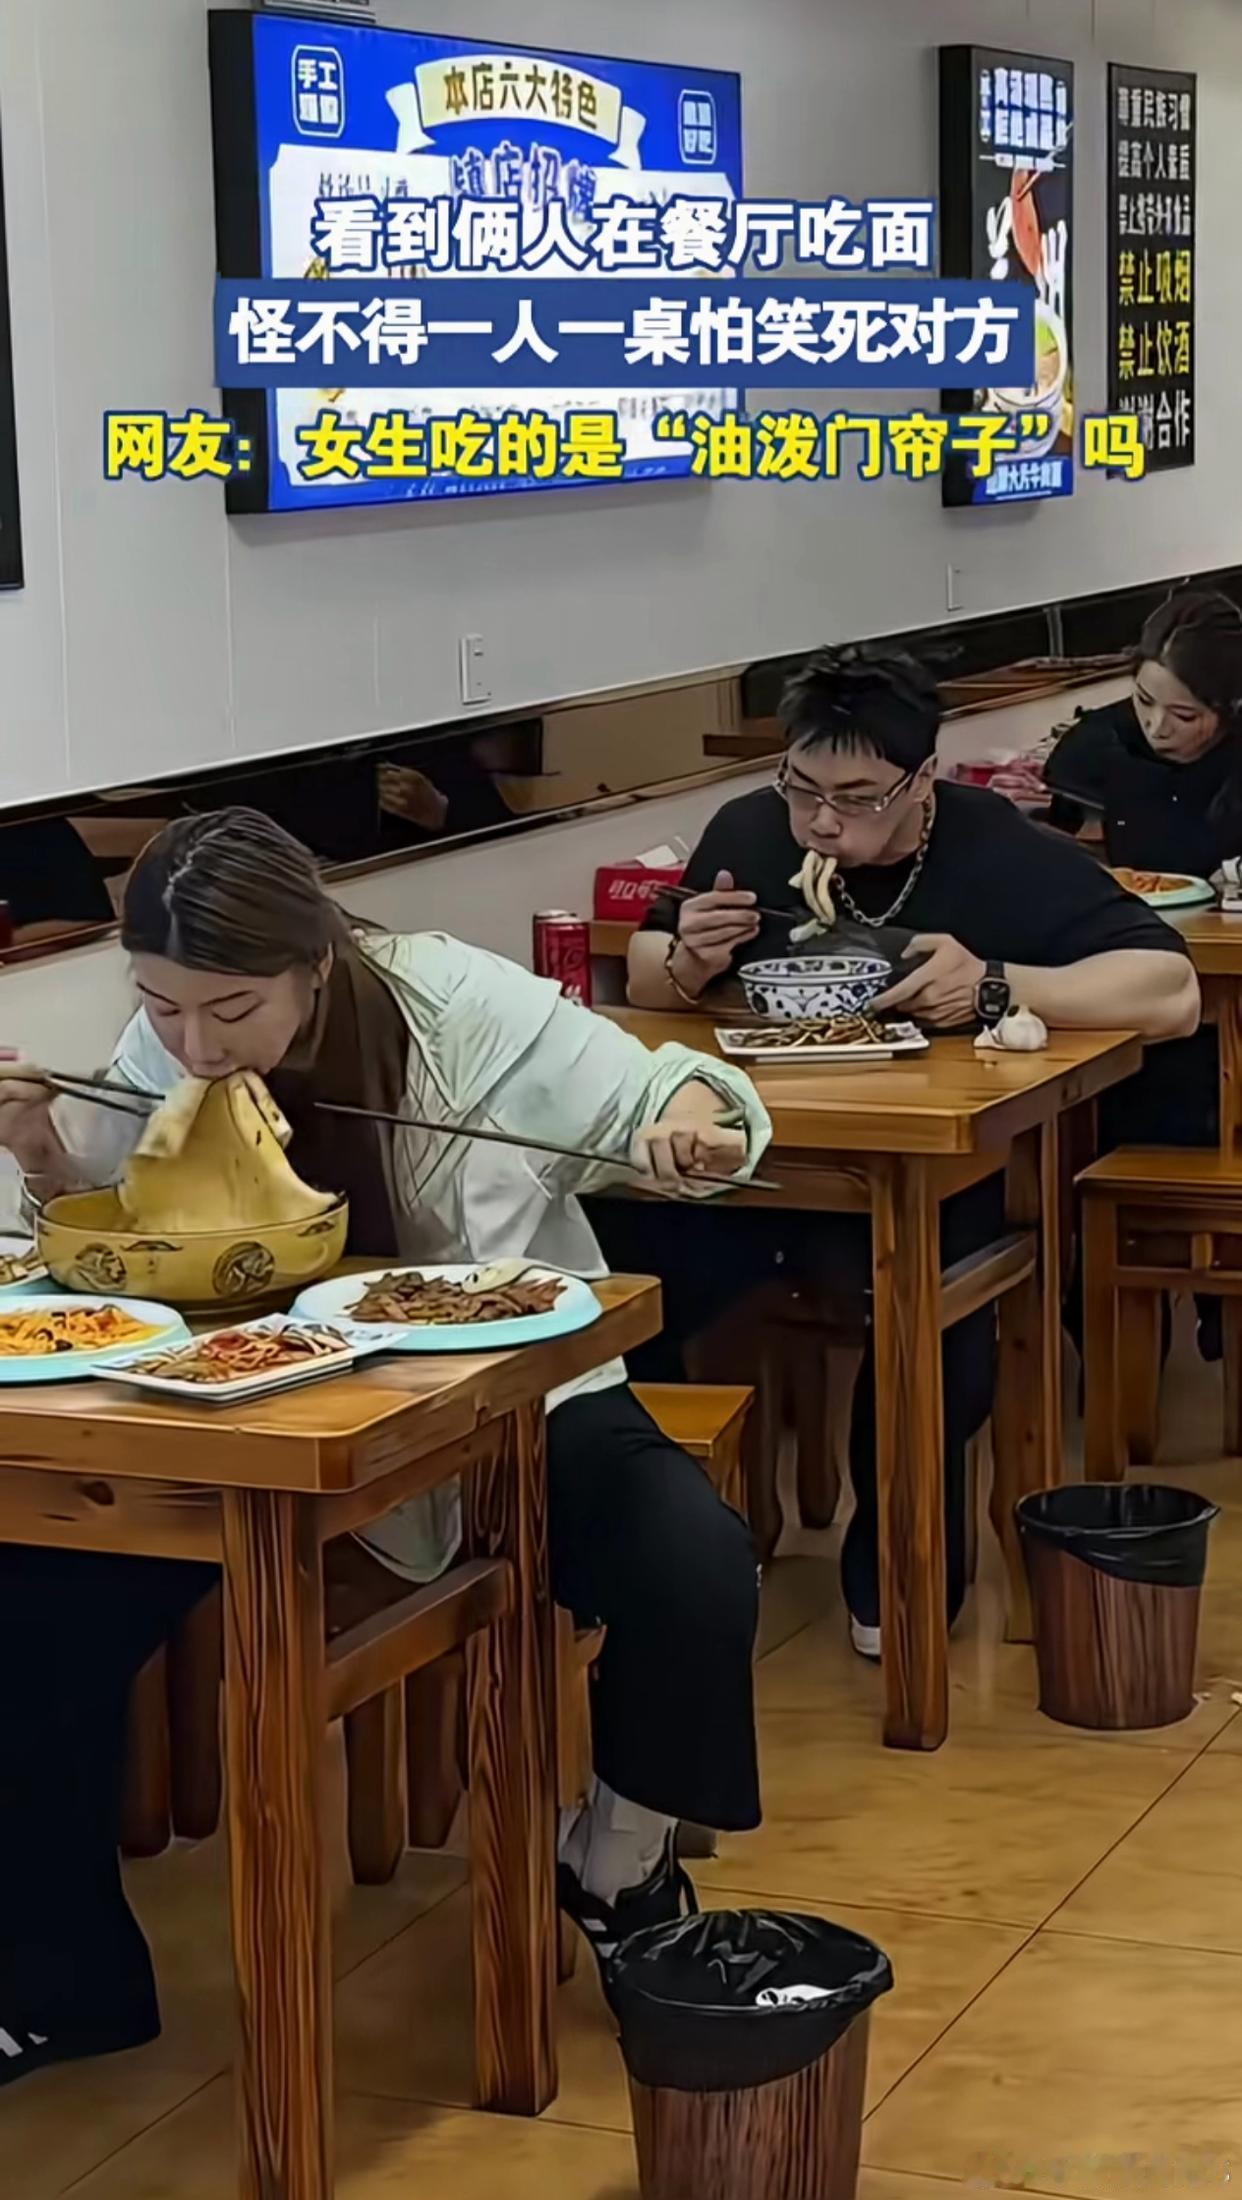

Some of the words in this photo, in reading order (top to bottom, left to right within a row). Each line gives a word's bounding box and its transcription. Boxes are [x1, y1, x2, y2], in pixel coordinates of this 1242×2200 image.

[298, 59, 338, 90] 手工
[444, 60, 599, 130] 本店六大特色
[1119, 249, 1191, 305] 禁止吸烟
[1119, 320, 1191, 379] 禁止饮酒
[1119, 389, 1191, 449] 谢合作
